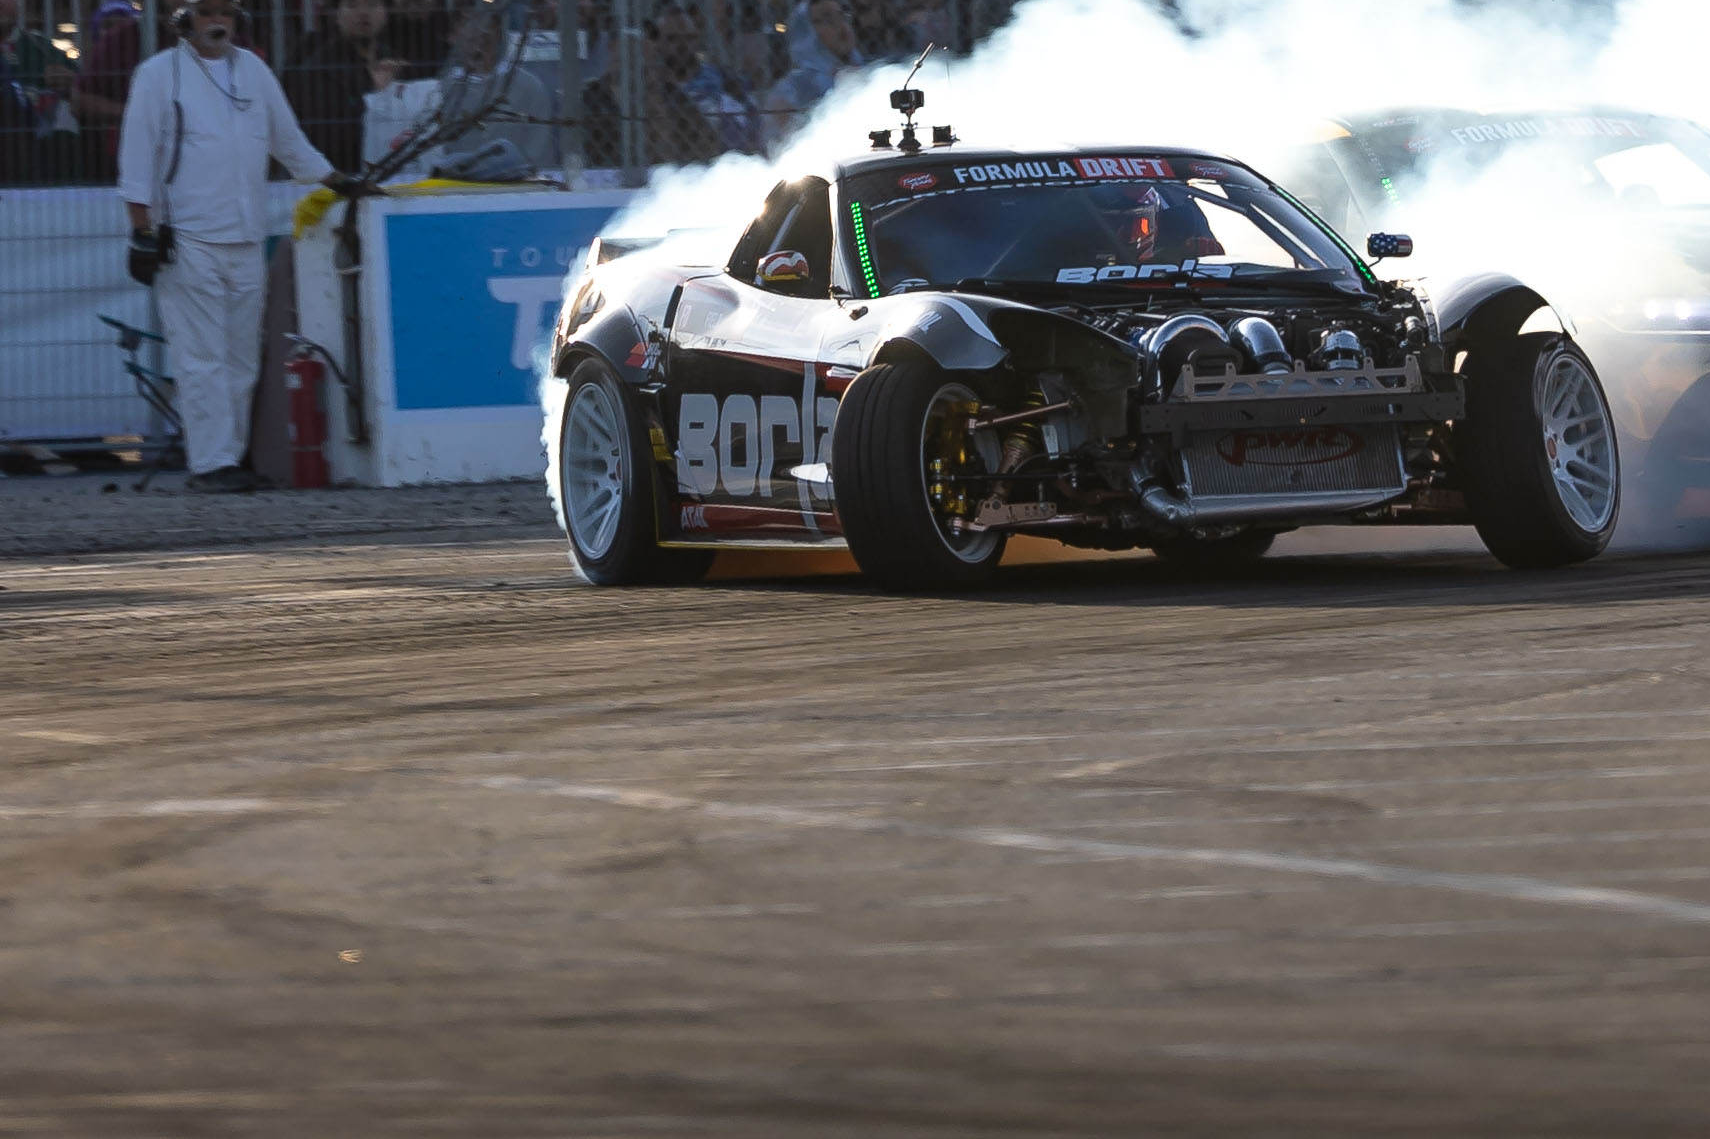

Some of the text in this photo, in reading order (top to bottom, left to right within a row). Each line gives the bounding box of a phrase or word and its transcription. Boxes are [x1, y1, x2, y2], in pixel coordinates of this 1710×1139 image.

[953, 161, 1077, 183] FORMULA
[1079, 158, 1166, 179] DRIFT
[491, 246, 577, 268] TOU
